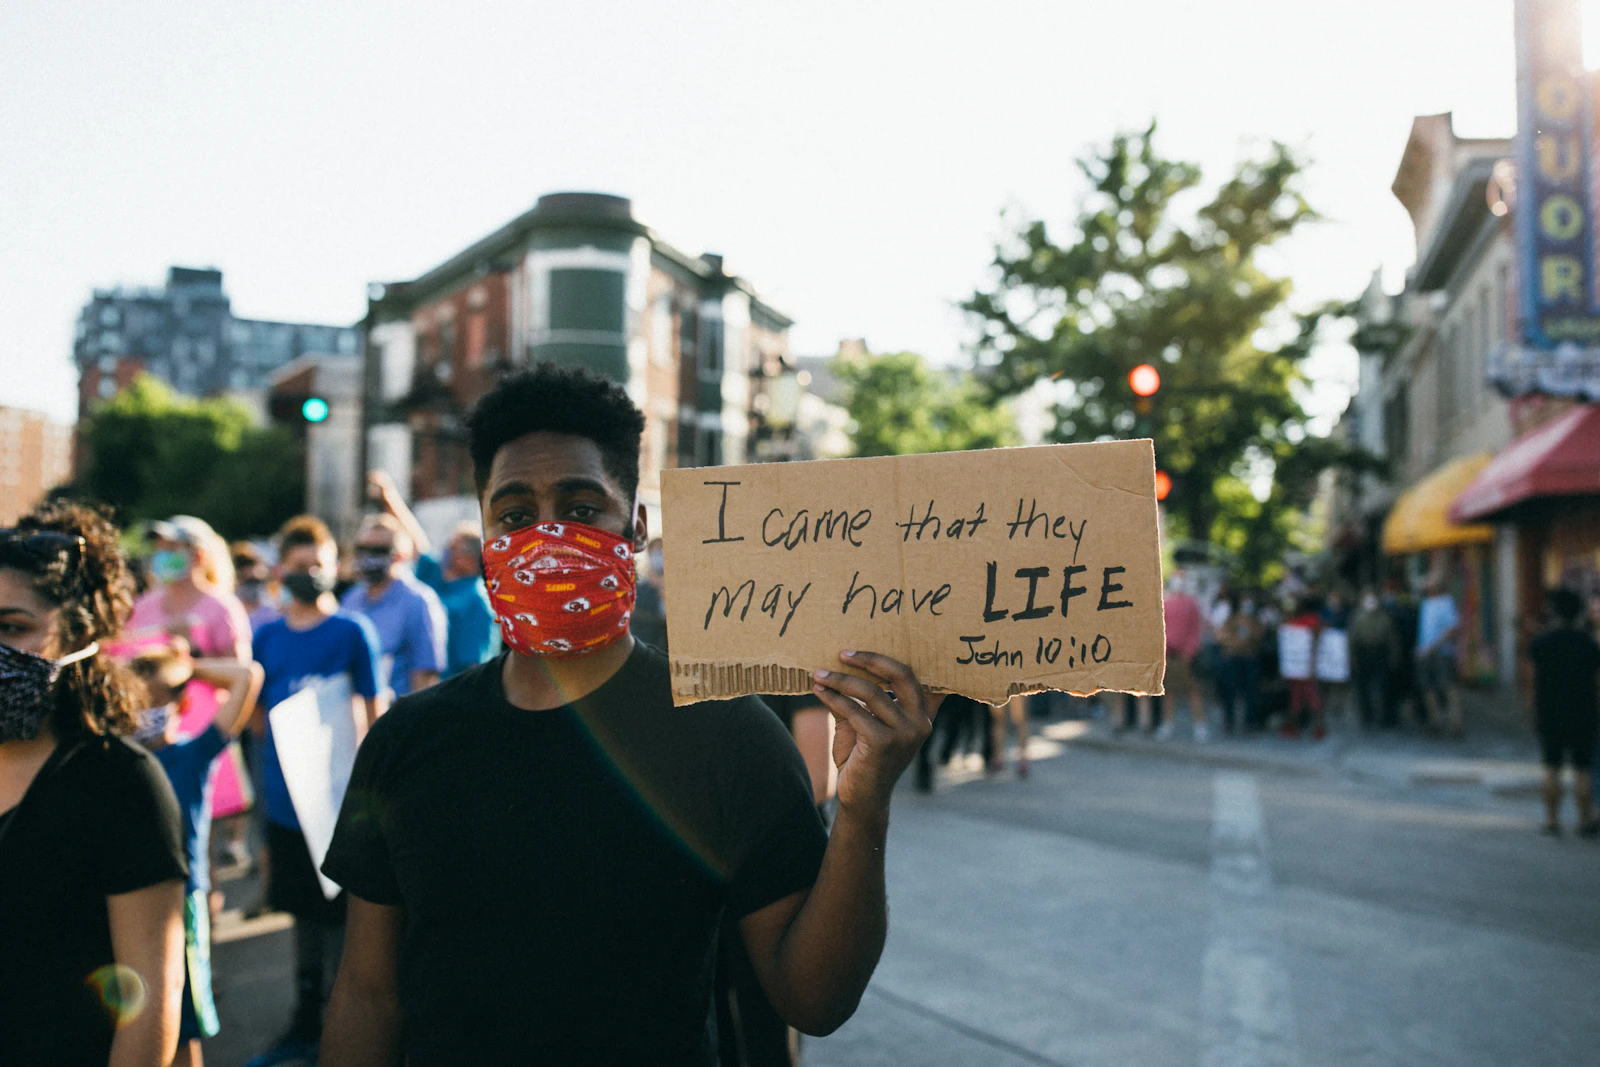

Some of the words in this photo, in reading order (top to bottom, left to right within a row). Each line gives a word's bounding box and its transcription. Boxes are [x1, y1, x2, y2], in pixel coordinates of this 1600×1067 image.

[702, 481, 745, 544] I
[762, 508, 872, 551] came
[896, 499, 988, 542] that
[1006, 497, 1088, 564] they
[545, 583, 576, 592] CHIEFS
[704, 579, 812, 638] may
[842, 571, 952, 620] have
[982, 560, 1134, 623] LIFE
[955, 634, 1023, 669] John
[1035, 633, 1112, 669] 10:10
